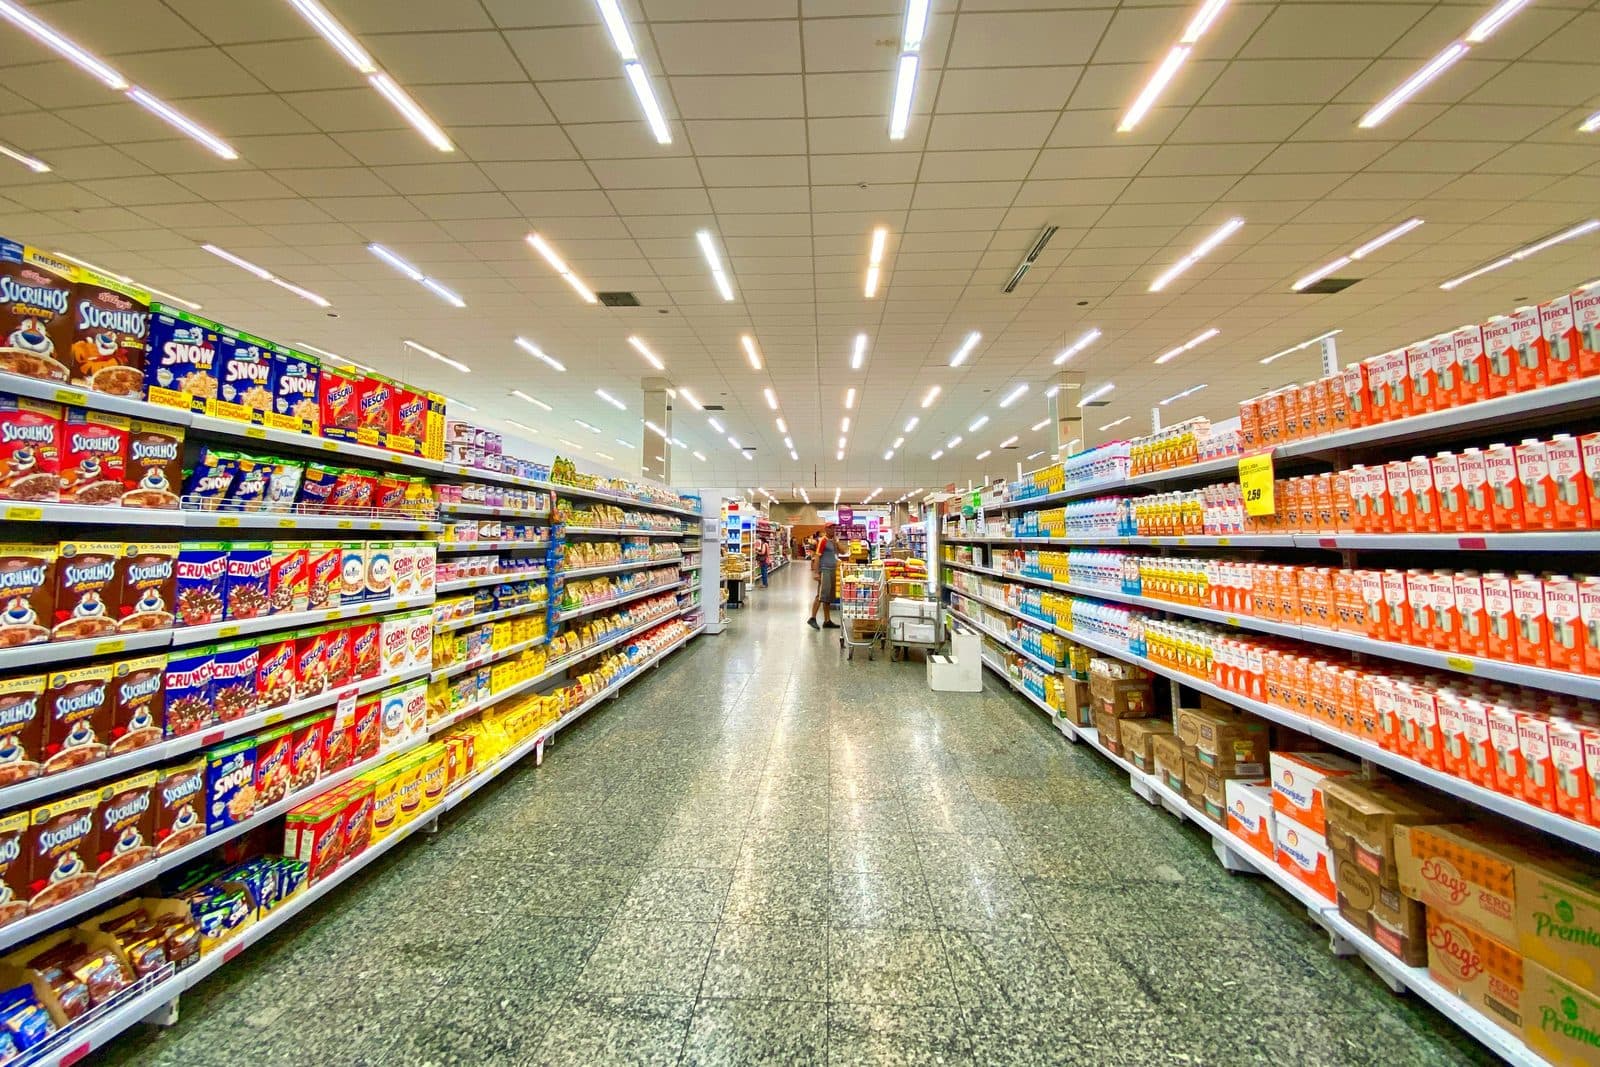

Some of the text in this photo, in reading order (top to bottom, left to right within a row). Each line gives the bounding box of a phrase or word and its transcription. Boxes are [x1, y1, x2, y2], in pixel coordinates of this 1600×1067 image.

[0, 276, 69, 314] SUCRILHOS
[79, 300, 147, 338] SUCRILHOS
[1542, 307, 1571, 322] TIROL
[1484, 326, 1510, 341] TIROL
[1511, 317, 1538, 332] TIROL
[1431, 345, 1454, 357] TIROL
[1455, 335, 1480, 349] TIROL
[161, 341, 215, 365] SNOW
[1409, 351, 1429, 363] TIROL
[226, 360, 270, 382] SNOW
[279, 375, 317, 395] SNOW
[327, 384, 354, 404] NESCAU
[361, 389, 390, 410] NESCAU
[399, 400, 424, 419] NESCAU
[2, 421, 54, 443] SUCRILHOS
[71, 433, 121, 453] SUCRILHOS
[132, 440, 178, 460] SUCRILHOS
[1584, 445, 1600, 457] TIR
[1486, 458, 1513, 468] TIROL
[1518, 454, 1546, 465] TIROL
[1549, 449, 1577, 461] TIROL
[1388, 471, 1406, 479] TIROL
[1410, 469, 1430, 477] TIROL
[1434, 465, 1457, 474] TIROL
[1460, 462, 1484, 472] TIROL
[177, 559, 227, 577] CRUNCH
[228, 557, 271, 576] CRUNCH
[279, 557, 305, 578] NESCAU
[393, 556, 413, 571] CORN
[416, 556, 433, 569] CORN
[65, 560, 116, 588] SUCRILHOS
[128, 560, 173, 585] SUCRILHOS
[1363, 579, 1380, 588] TIROL
[1384, 580, 1402, 590] TIROL
[1408, 582, 1428, 592] TIROL
[1429, 584, 1452, 594] TIROL
[1455, 585, 1479, 596] TIROL
[1485, 587, 1510, 598] TIROL
[1513, 589, 1540, 600] TIROL
[1546, 591, 1576, 603] TIROL
[354, 628, 377, 655] NESCAU
[386, 628, 406, 646] CORN
[411, 625, 429, 641] CORN
[260, 647, 293, 682] NESCAU
[299, 641, 326, 671] NESCAU
[166, 660, 215, 688] CRUNCH
[214, 653, 259, 678] CRUNCH
[120, 673, 162, 705] SUCRILHOS
[55, 685, 106, 720] SUCRILHOS
[407, 697, 424, 713] CORN
[1413, 700, 1433, 712] TIROL
[357, 705, 380, 735] NESCAU
[1439, 706, 1462, 719] TIROL
[1462, 713, 1486, 726] TIROL
[1489, 720, 1517, 734] TIROL
[1519, 727, 1547, 743] TIROL
[293, 730, 319, 765] NESCAU
[1551, 736, 1581, 751] TIROL
[258, 743, 289, 781] NESCAU
[163, 773, 203, 808] SUCRILHOS
[213, 763, 254, 802] SNOW
[104, 790, 150, 830] SUCRILHOS
[347, 796, 373, 831] NESCAU
[39, 812, 92, 855] SUCRILHOS
[317, 813, 343, 851] NESCAU
[1479, 889, 1512, 913] ZERO
[1488, 976, 1519, 1001] ZERO
